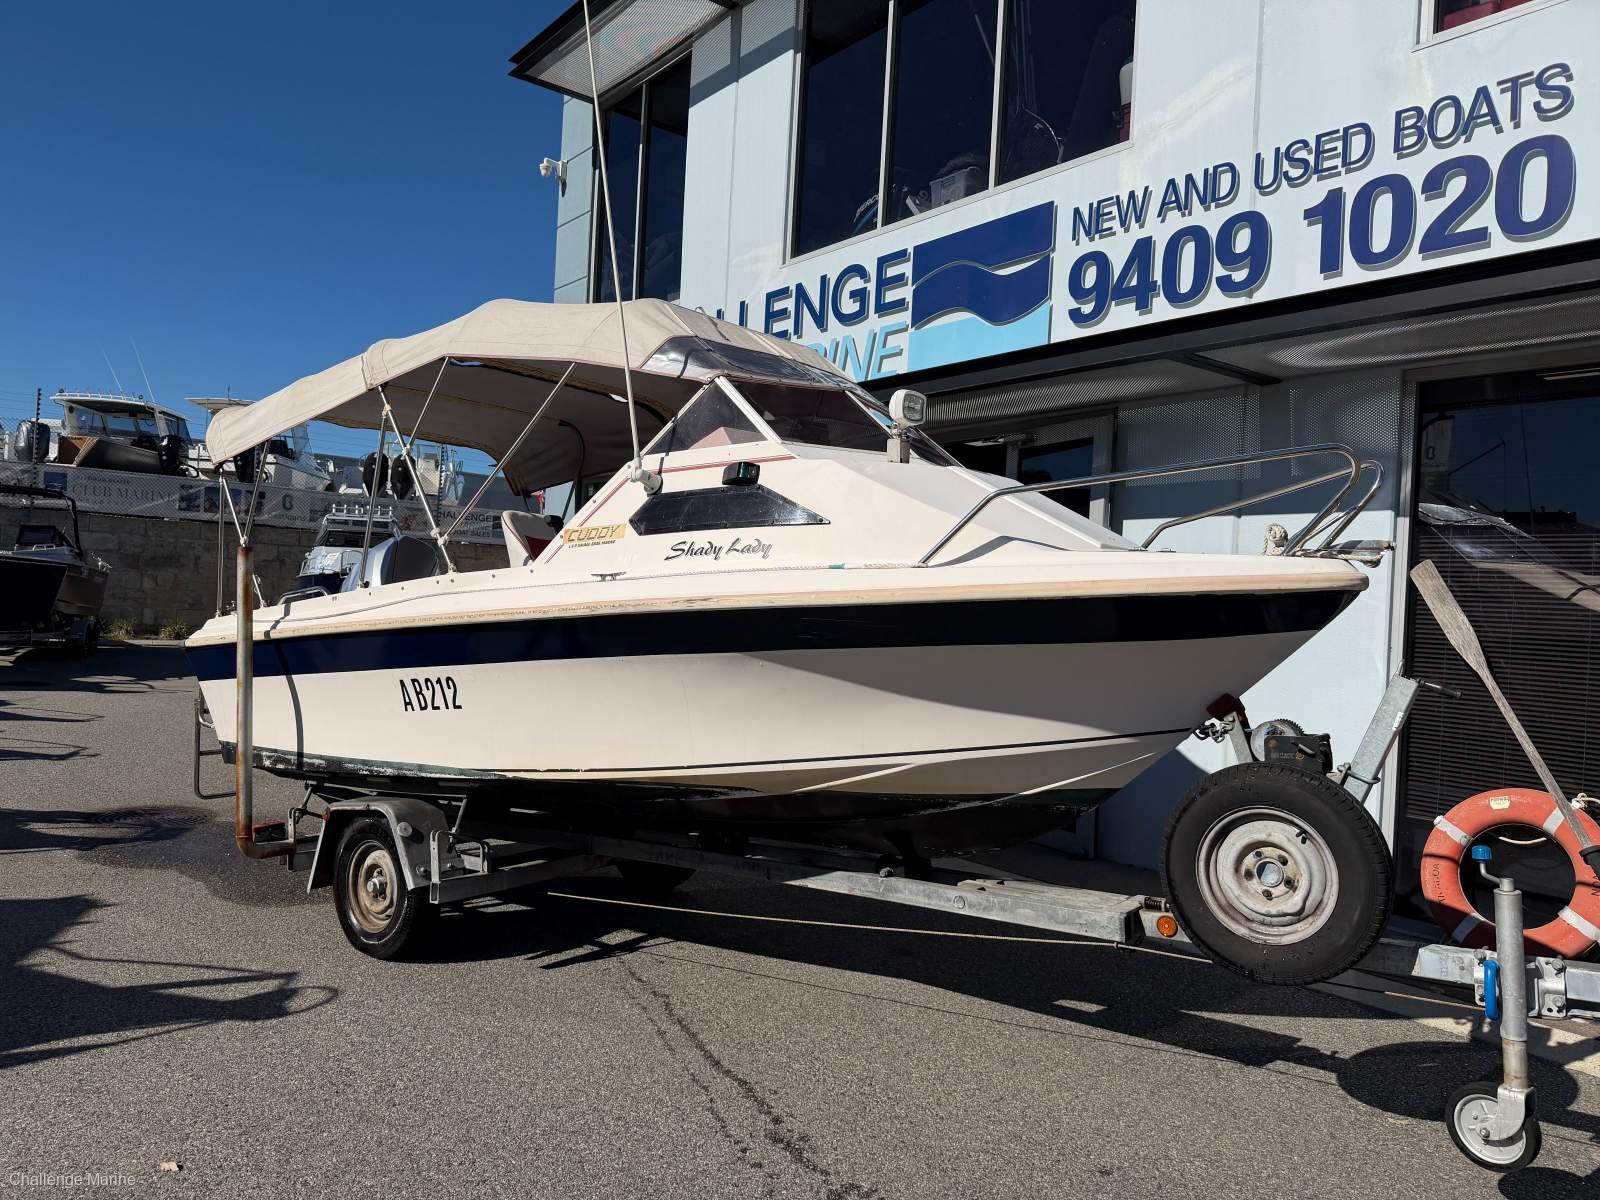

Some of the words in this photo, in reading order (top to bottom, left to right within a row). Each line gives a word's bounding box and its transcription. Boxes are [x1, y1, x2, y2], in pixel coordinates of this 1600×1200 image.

[1072, 186, 1148, 241] NEW
[1157, 161, 1237, 220] AND
[1254, 121, 1373, 196] USED
[1393, 62, 1573, 157] BOATS
[1067, 210, 1270, 326] 9409
[1303, 134, 1575, 277] 1020
[431, 510, 493, 522] CHALENGE
[664, 541, 723, 561] Shady
[725, 537, 773, 559] Lady
[399, 676, 463, 712] AB212
